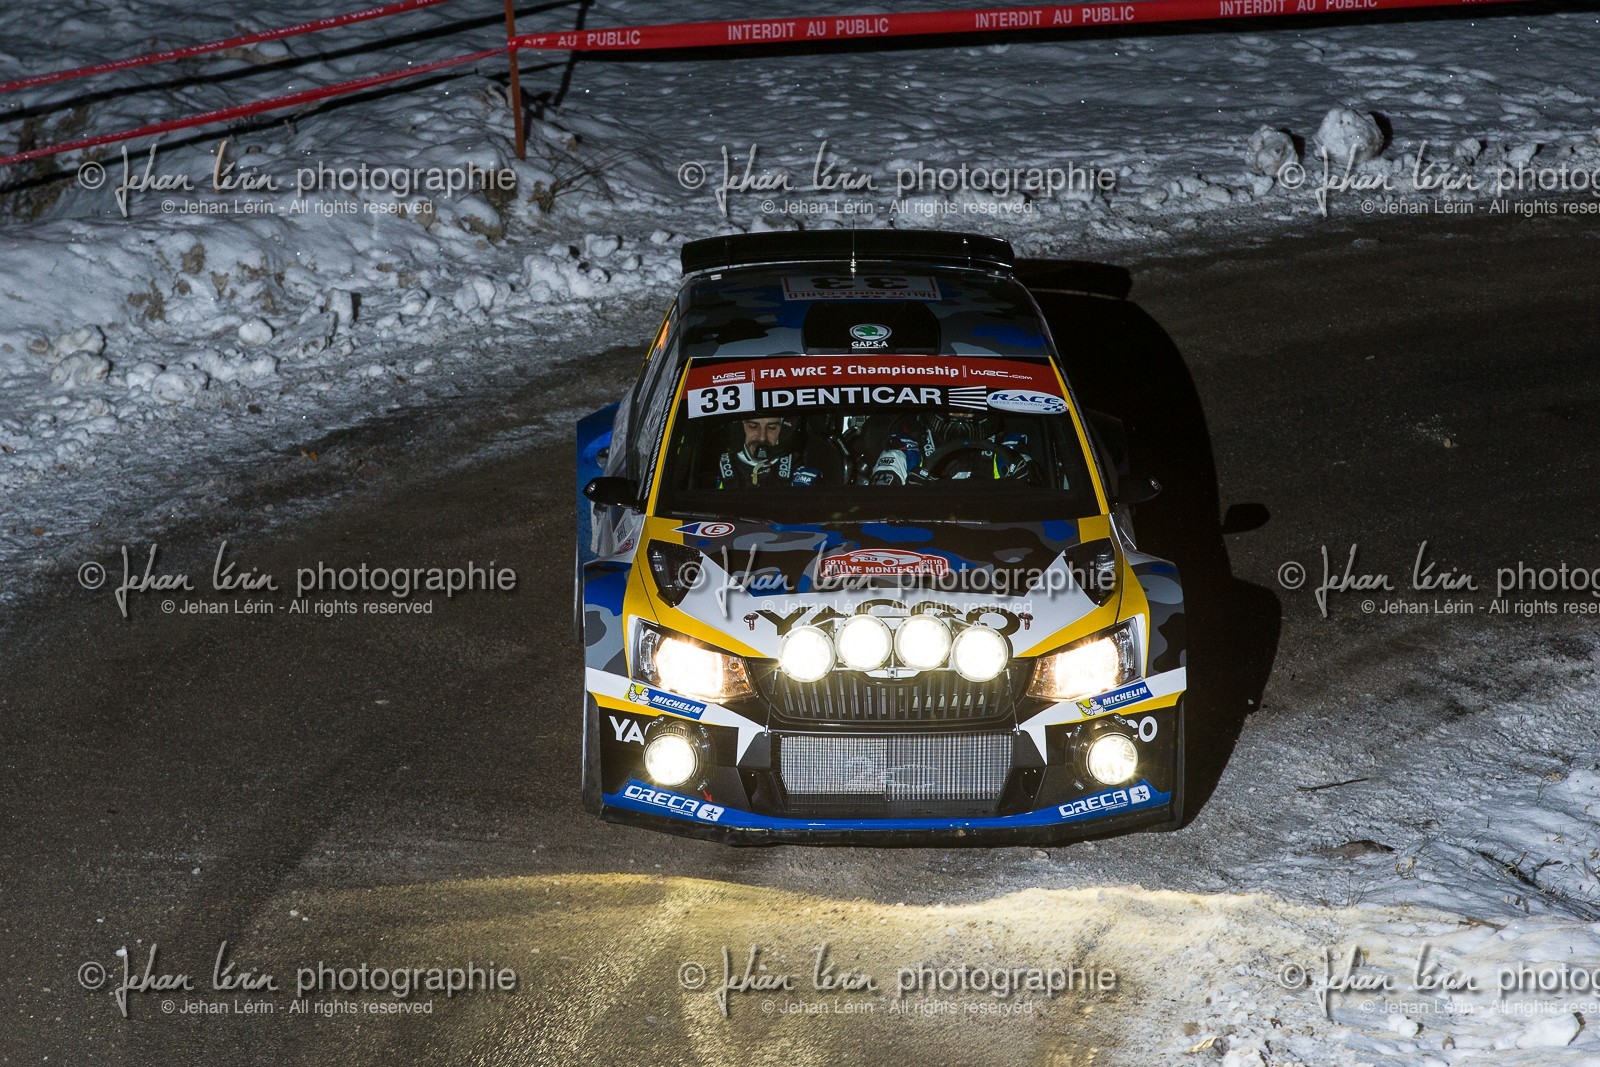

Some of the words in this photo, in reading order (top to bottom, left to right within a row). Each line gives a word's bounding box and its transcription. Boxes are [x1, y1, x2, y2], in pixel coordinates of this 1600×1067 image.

[975, 11, 1042, 29] INTERDIT
[1053, 9, 1074, 26] AU
[1082, 5, 1136, 23] PUBLIC
[1219, 0, 1285, 16] INTERDIT
[557, 35, 577, 47] AU
[587, 30, 641, 46] PUBLIC
[727, 22, 796, 41] INTERDIT
[806, 20, 827, 36] AU
[836, 18, 890, 35] PUBLIC
[760, 368, 787, 379] FIA
[790, 366, 827, 377] WRC
[832, 365, 842, 375] 2
[847, 364, 959, 377] Championship
[700, 385, 741, 414] 33
[761, 387, 942, 409] IDENTICAR
[825, 564, 863, 574] RALLYE
[652, 695, 704, 714] MICHELIN
[1102, 686, 1148, 706] MICHELIN
[624, 785, 700, 812] ORECA
[1058, 789, 1128, 816] ORECA
